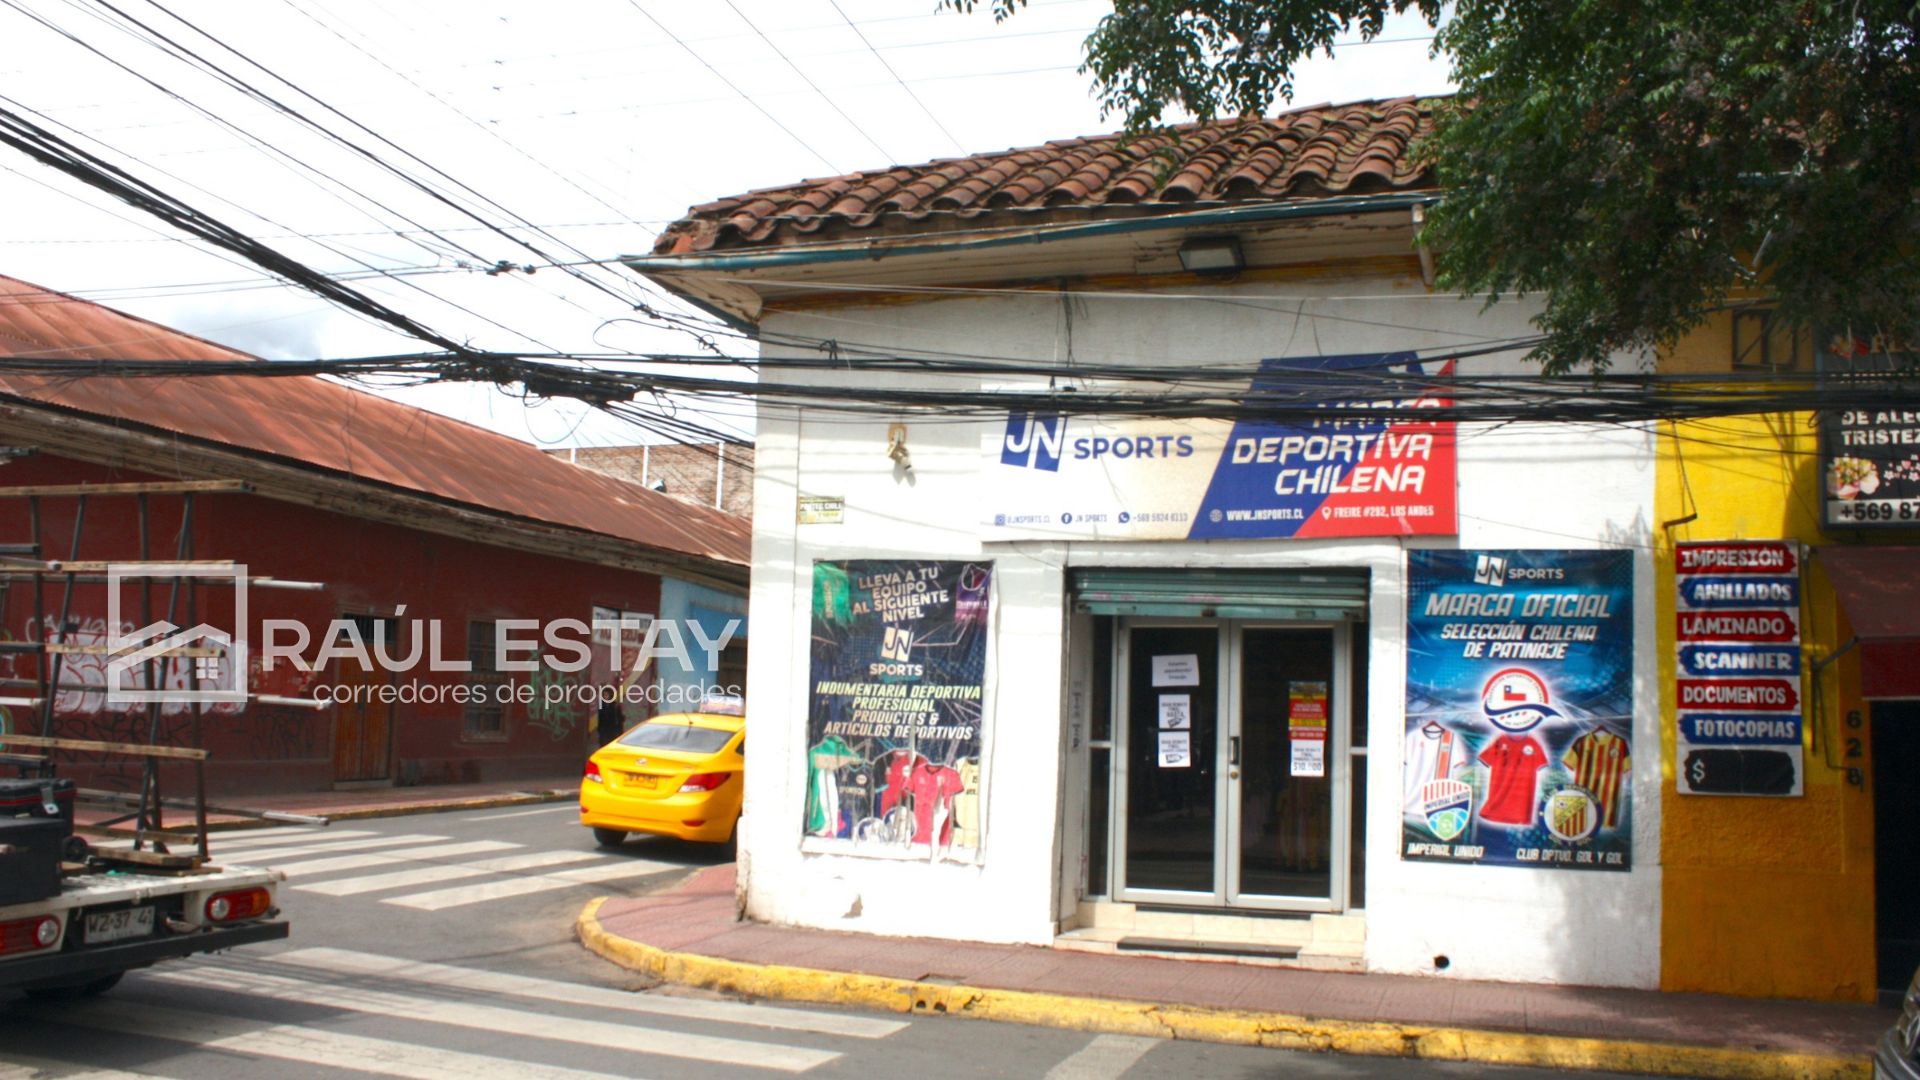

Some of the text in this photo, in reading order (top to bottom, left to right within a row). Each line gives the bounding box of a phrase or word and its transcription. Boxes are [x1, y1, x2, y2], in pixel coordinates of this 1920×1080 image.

[1841, 411, 1869, 425] DE
[1074, 435, 1194, 460] SPORTS
[1232, 430, 1434, 465] DEPORTIVA
[1274, 463, 1426, 496] CHILENA
[1841, 502, 1892, 520] +569
[859, 567, 939, 589] LLEVA A TU
[1474, 555, 1565, 587] JN SPORTS
[872, 581, 927, 599] EQUIPO
[853, 602, 870, 615] AL
[874, 590, 949, 611] SIGUIENTE
[1424, 593, 1611, 617] MARCA OFICIAL
[883, 607, 924, 622] NIVEL
[1440, 620, 1598, 641] SELECCIÓN CHILENA
[1682, 617, 1785, 635] LAMINADO
[881, 626, 914, 662] JN
[1463, 641, 1568, 659] DE PATINAJE
[869, 663, 924, 676] SPORTS
[1694, 652, 1792, 669] SCANNER
[816, 681, 981, 699] INDUMENTARIA DEPORTIVA
[1683, 686, 1787, 704] DOCUMENTOS
[852, 697, 935, 712] PROFESIONAL
[929, 713, 939, 725] &
[894, 725, 973, 740] DEORTIVOS
[1694, 719, 1795, 738] FOTOCOPIAS
[1692, 758, 1705, 783] $
[1407, 843, 1484, 858] IMPERIAL UNIDO
[1516, 848, 1539, 860] CLUB
[1576, 850, 1592, 862] GOL
[1597, 851, 1604, 863] Y
[1606, 851, 1622, 864] GOL
